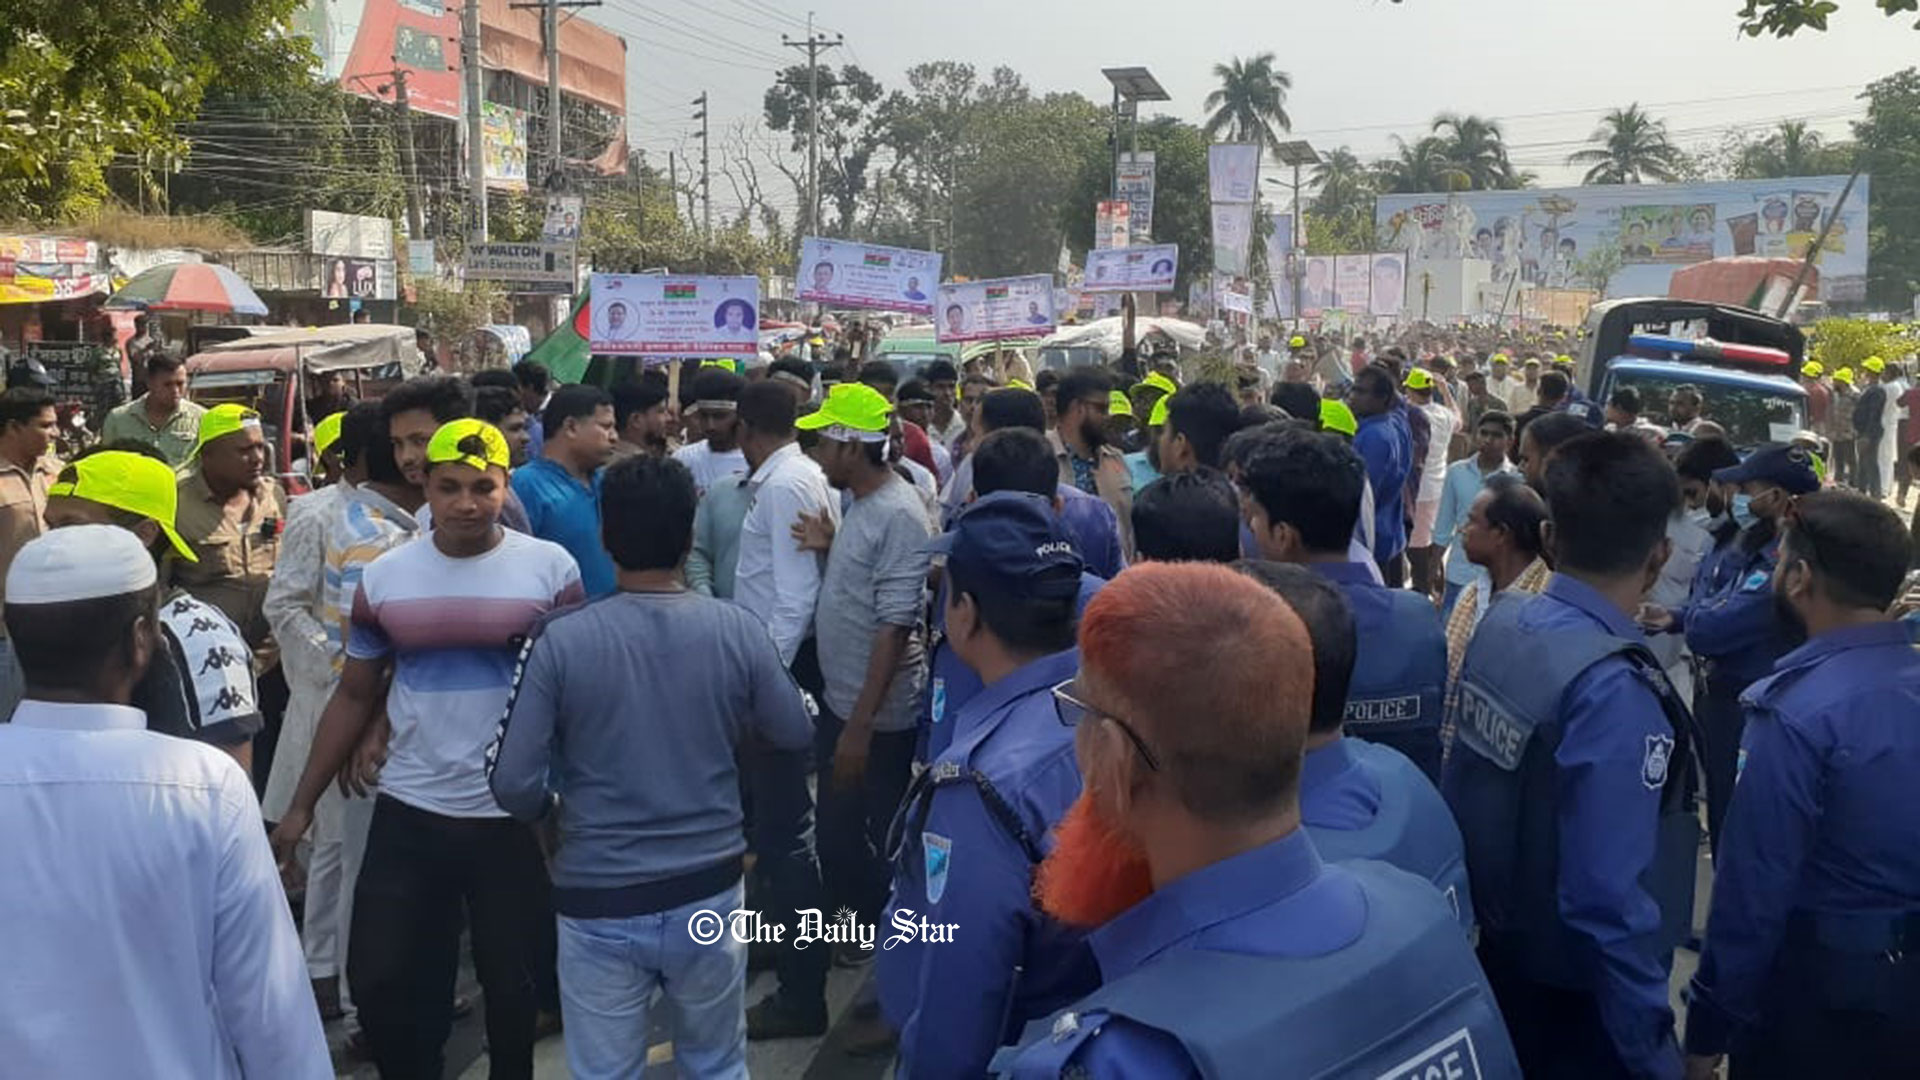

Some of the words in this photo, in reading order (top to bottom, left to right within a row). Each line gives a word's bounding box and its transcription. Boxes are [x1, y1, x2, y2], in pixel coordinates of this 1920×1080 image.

[487, 245, 541, 258] WALTON
[353, 279, 375, 297] LUX
[1344, 700, 1407, 720] POLICE
[1463, 689, 1522, 764] POLICE
